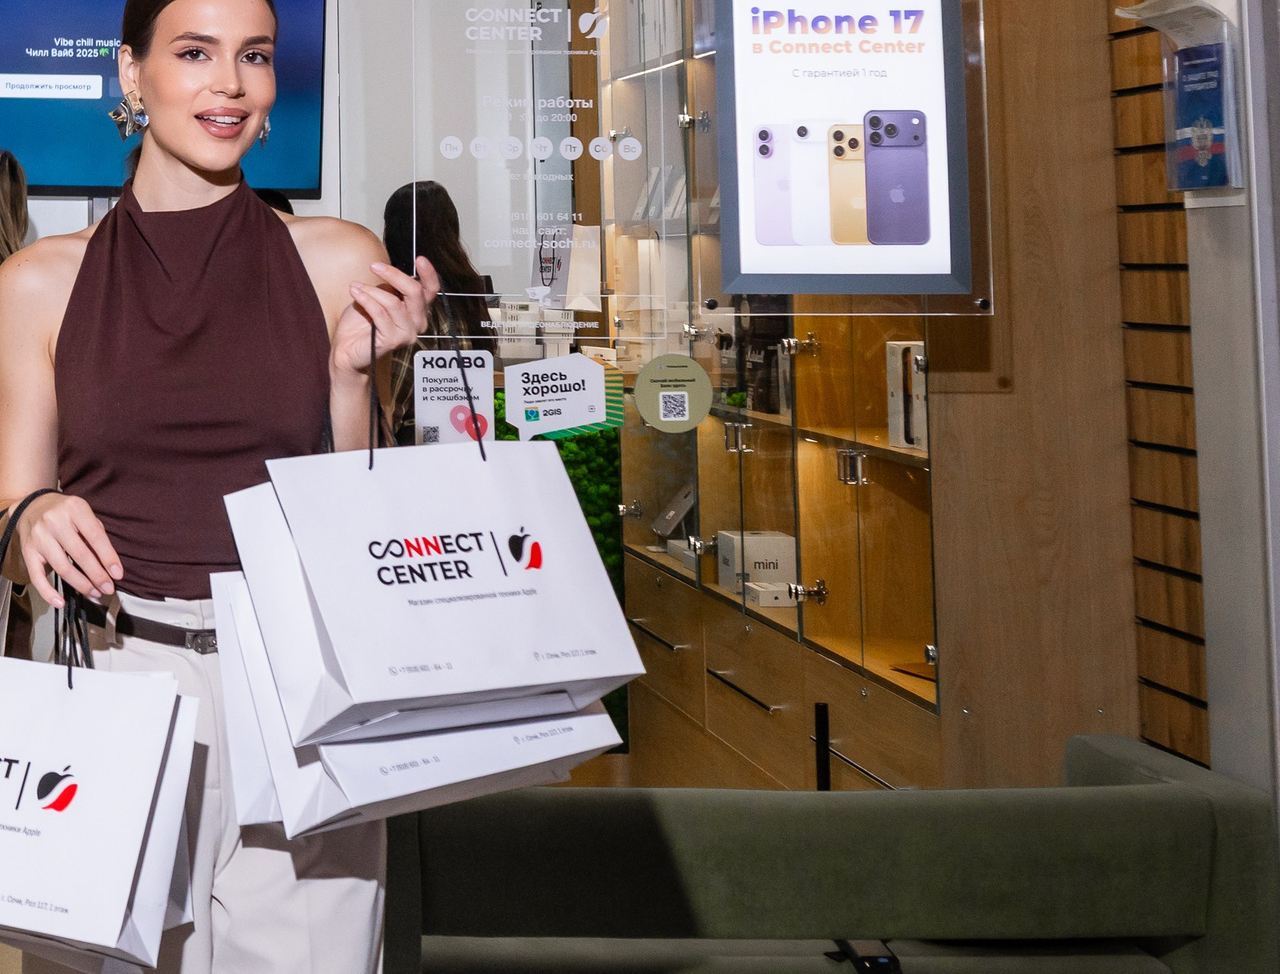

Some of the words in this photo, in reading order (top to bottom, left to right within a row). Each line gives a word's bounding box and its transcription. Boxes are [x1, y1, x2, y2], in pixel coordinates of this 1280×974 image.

[465, 8, 562, 23] CONNECT
[750, 7, 879, 35] iPhone
[889, 9, 925, 34] 17
[465, 26, 542, 41] CENTER
[53, 37, 74, 47] Vibe
[76, 38, 93, 47] chill
[95, 38, 121, 47] music
[752, 42, 763, 54] в
[769, 40, 853, 54] Connect
[858, 39, 926, 54] Center
[25, 48, 49, 57] Чилл
[51, 48, 74, 57] Вайб
[76, 48, 99, 58] 2025
[803, 68, 859, 79] гарантией
[869, 69, 888, 79] год
[5, 82, 53, 90] Продолжить
[538, 96, 593, 111] работы
[551, 114, 577, 123] 20:00
[445, 143, 458, 152] Пн
[565, 145, 577, 153] Пт
[594, 143, 608, 153] Сб
[623, 144, 637, 153] Вс
[538, 212, 554, 222] 601
[556, 212, 569, 221] 64
[572, 212, 583, 221] 11
[538, 226, 567, 236] сайт:
[483, 237, 597, 250] connect-sochi.ru
[422, 376, 459, 384] Покупай
[521, 371, 567, 386] Здесь
[522, 379, 586, 397] хорошо!
[436, 393, 480, 401] кэшбэкм
[542, 409, 562, 417] 2GIS
[368, 532, 484, 560] CONNECT
[754, 559, 779, 570] mini
[377, 560, 473, 586] CENTER
[22, 826, 41, 837] Apple
